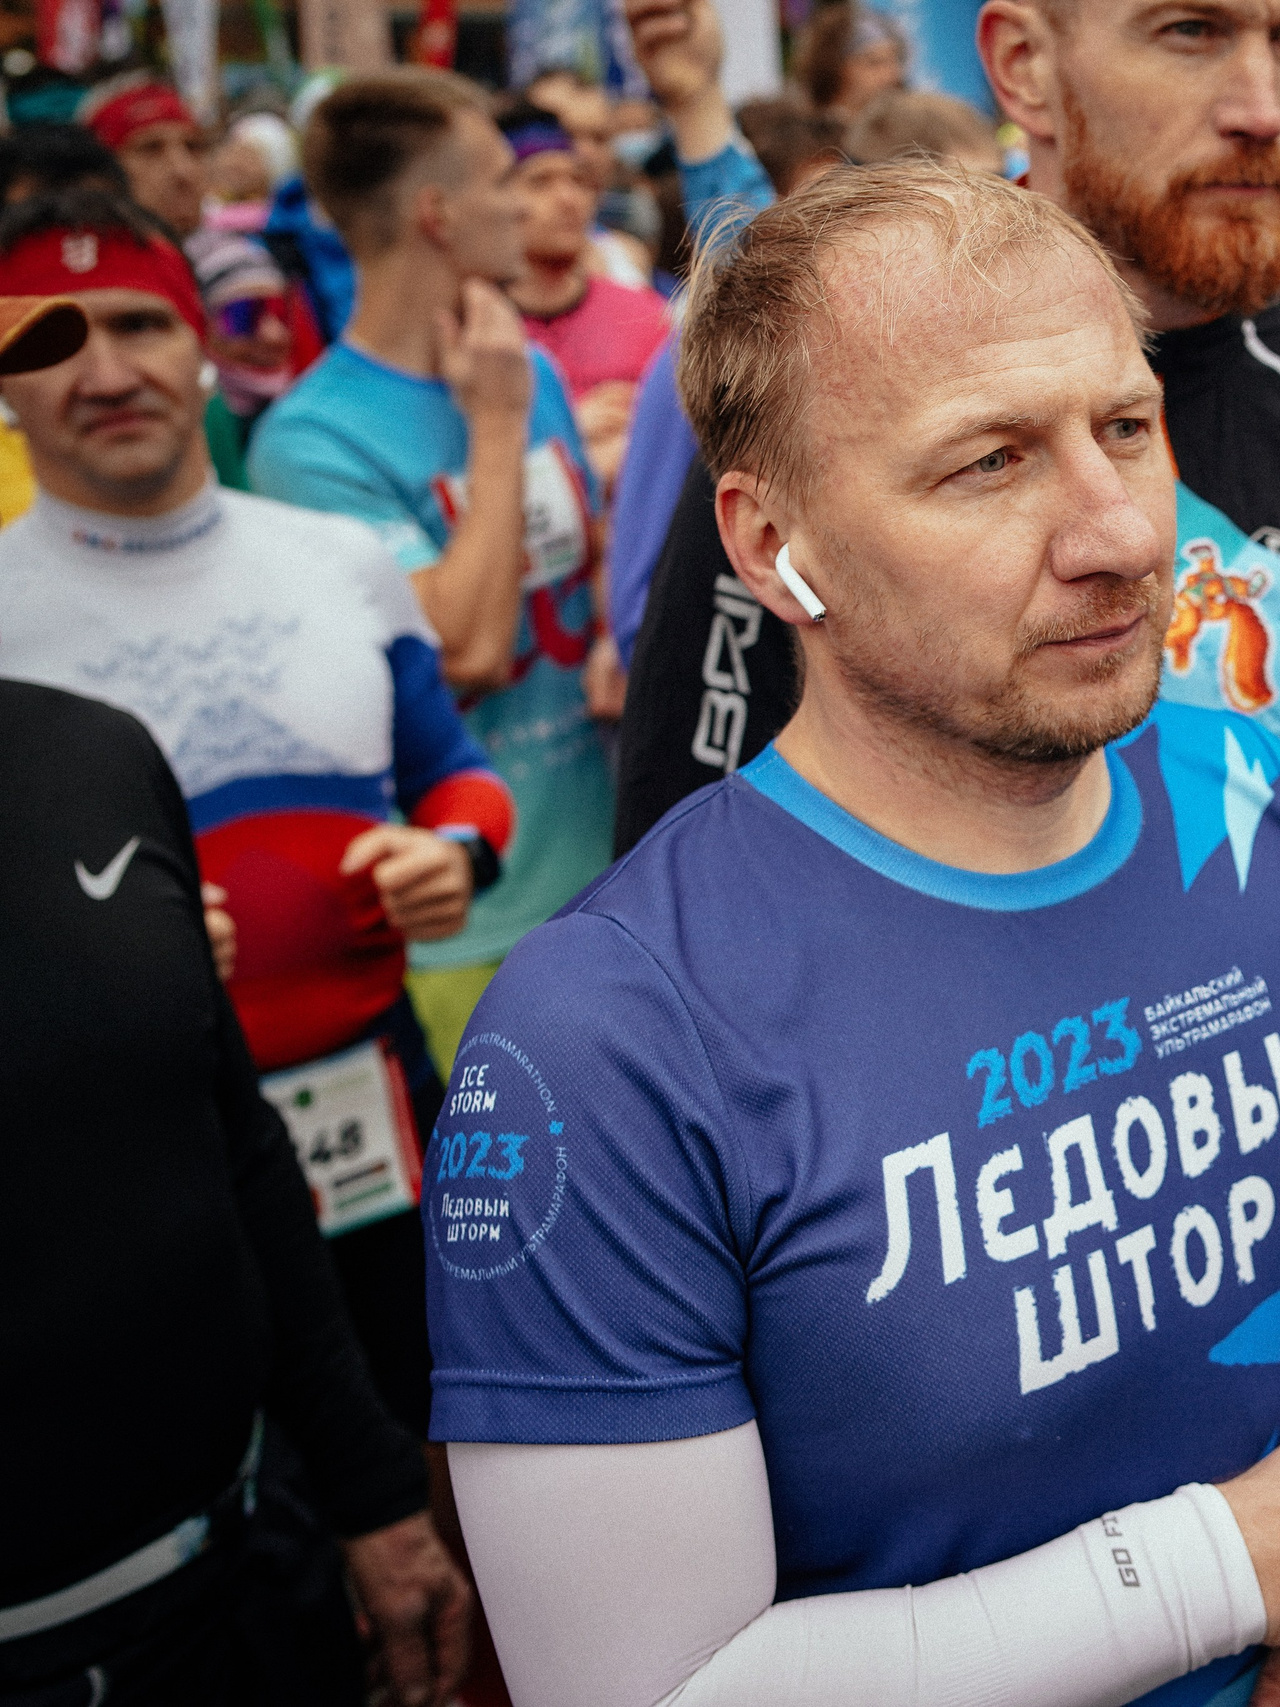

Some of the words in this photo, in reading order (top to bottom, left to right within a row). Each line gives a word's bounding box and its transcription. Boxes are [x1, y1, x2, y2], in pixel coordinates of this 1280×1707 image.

[1144, 964, 1245, 1023] БАЙКАЛЬСКИЙ
[1150, 974, 1269, 1041] ЭКСТРЕМАЛЬНЫЙ
[1154, 996, 1273, 1060] УЛЬТРАМАРАФОН
[460, 1063, 490, 1090] ICE
[479, 1032, 557, 1113] ULTRAMARATHON
[966, 997, 1142, 1129] 2023
[450, 1090, 497, 1117] STORM
[436, 1131, 531, 1185] 2023
[447, 1222, 501, 1242] ШТОРМ
[1112, 1547, 1141, 1588] GO
